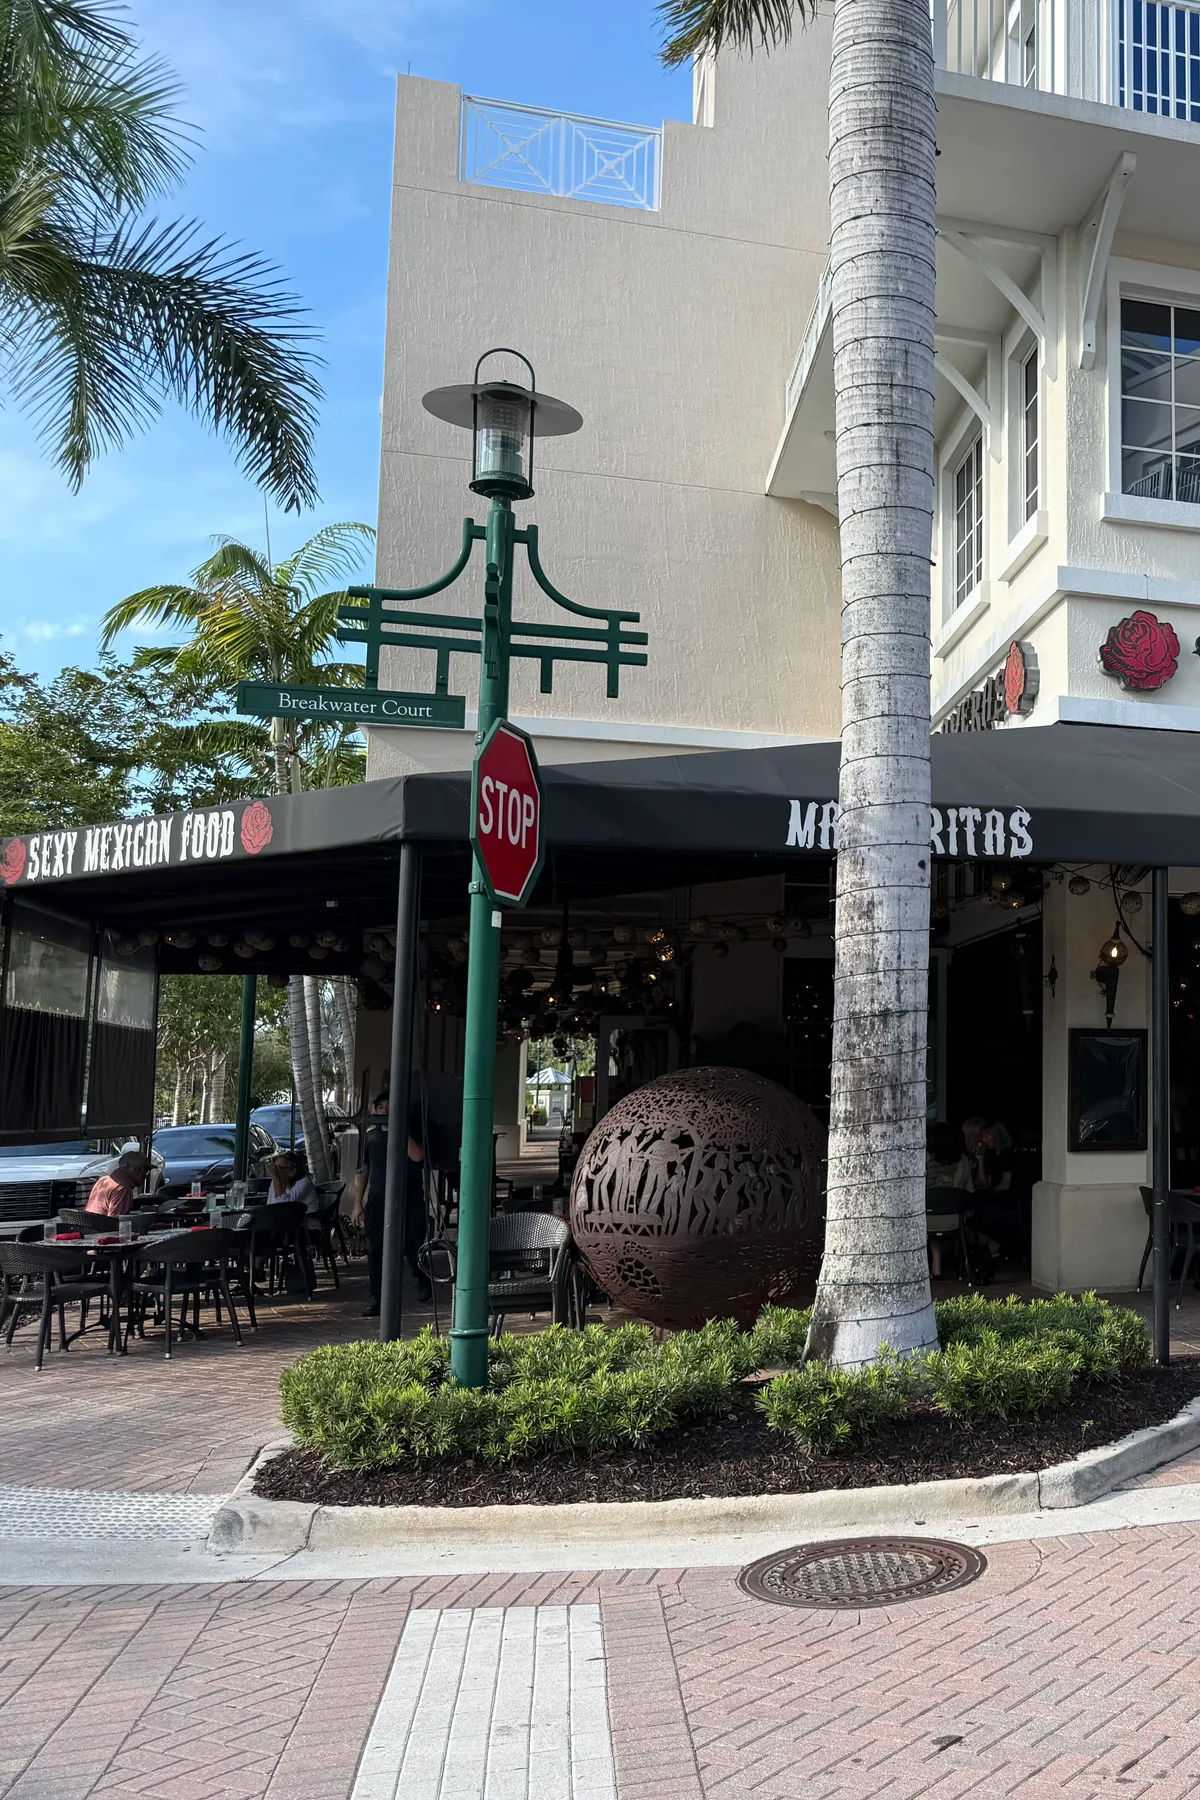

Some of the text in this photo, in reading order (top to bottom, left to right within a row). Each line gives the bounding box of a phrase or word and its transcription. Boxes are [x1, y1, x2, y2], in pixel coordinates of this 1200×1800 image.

[278, 692, 432, 717] Breakwater Court
[479, 775, 535, 849] STOP
[785, 799, 1034, 859] MARITAS
[27, 810, 235, 881] SEXY MEXICAN FOOD
